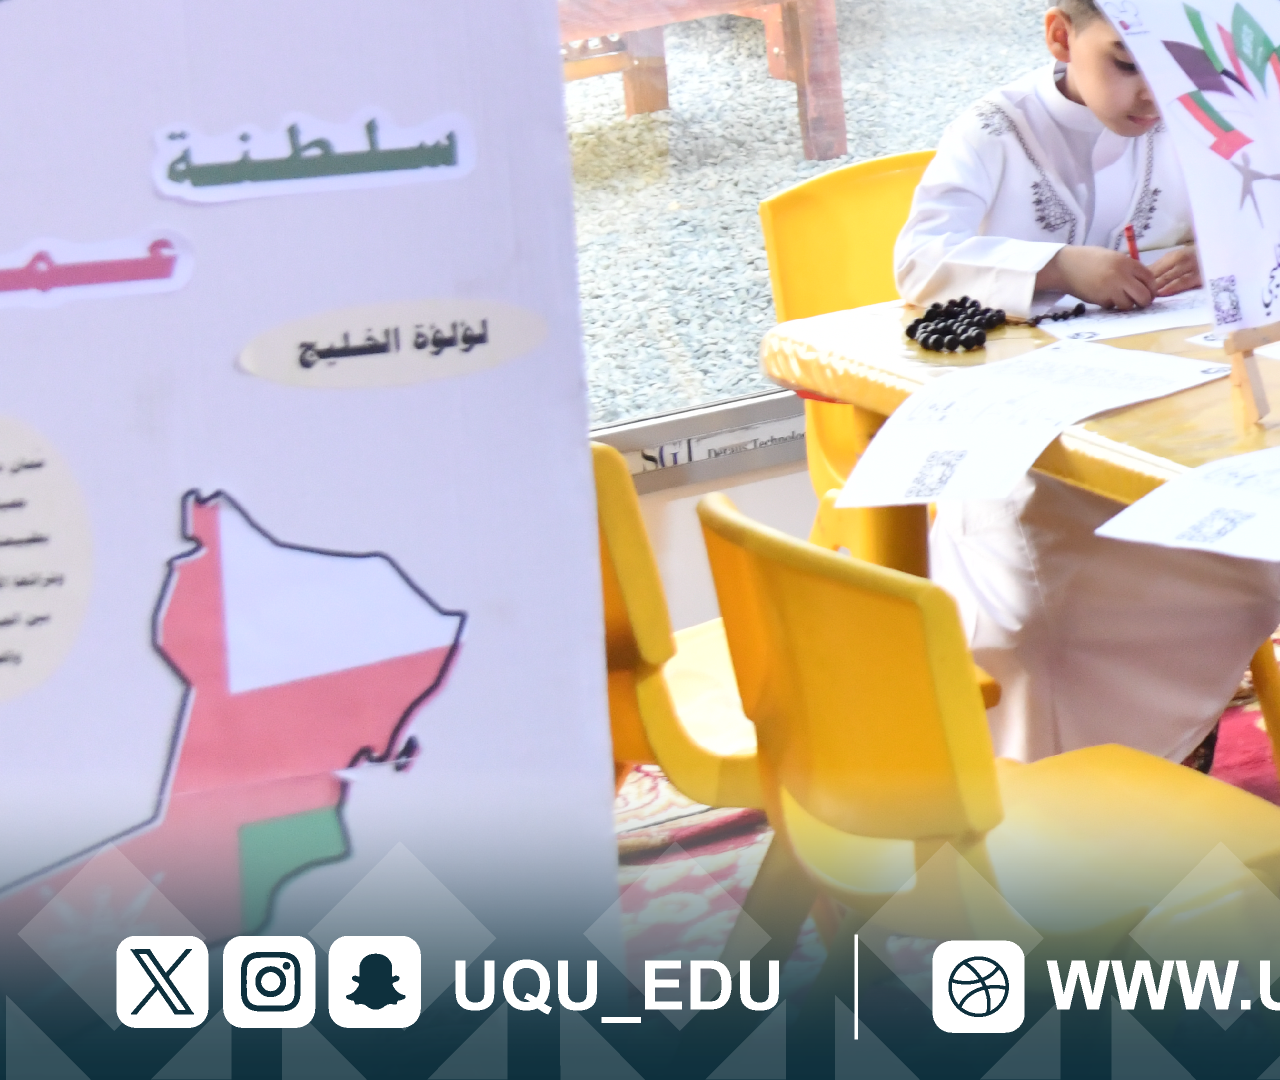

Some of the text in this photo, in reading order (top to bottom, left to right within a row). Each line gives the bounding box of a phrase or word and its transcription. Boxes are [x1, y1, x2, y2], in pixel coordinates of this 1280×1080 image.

[167, 117, 460, 188] سلطنة
[297, 317, 490, 370] لؤلؤة الخليج
